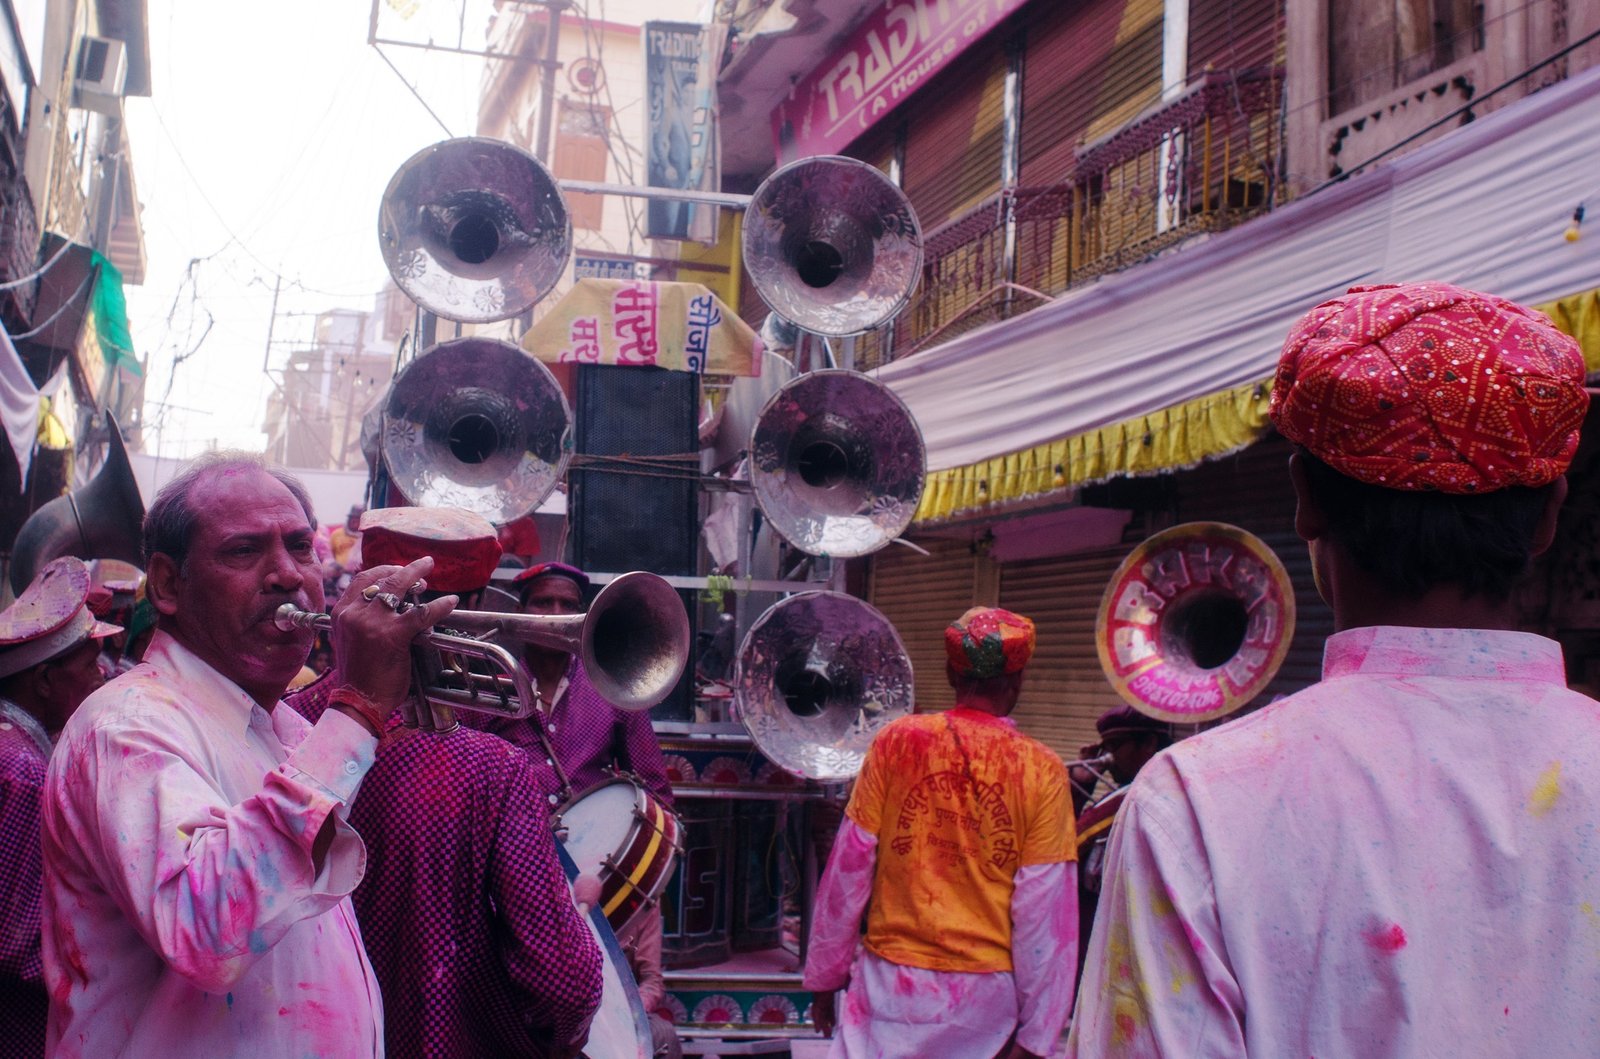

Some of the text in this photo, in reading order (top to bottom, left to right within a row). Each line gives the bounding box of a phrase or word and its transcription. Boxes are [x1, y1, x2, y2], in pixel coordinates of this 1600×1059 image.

[891, 37, 957, 99] House
[1113, 543, 1279, 688] PRAKASH
[897, 784, 930, 830] माथुर
[891, 835, 913, 856] श्री
